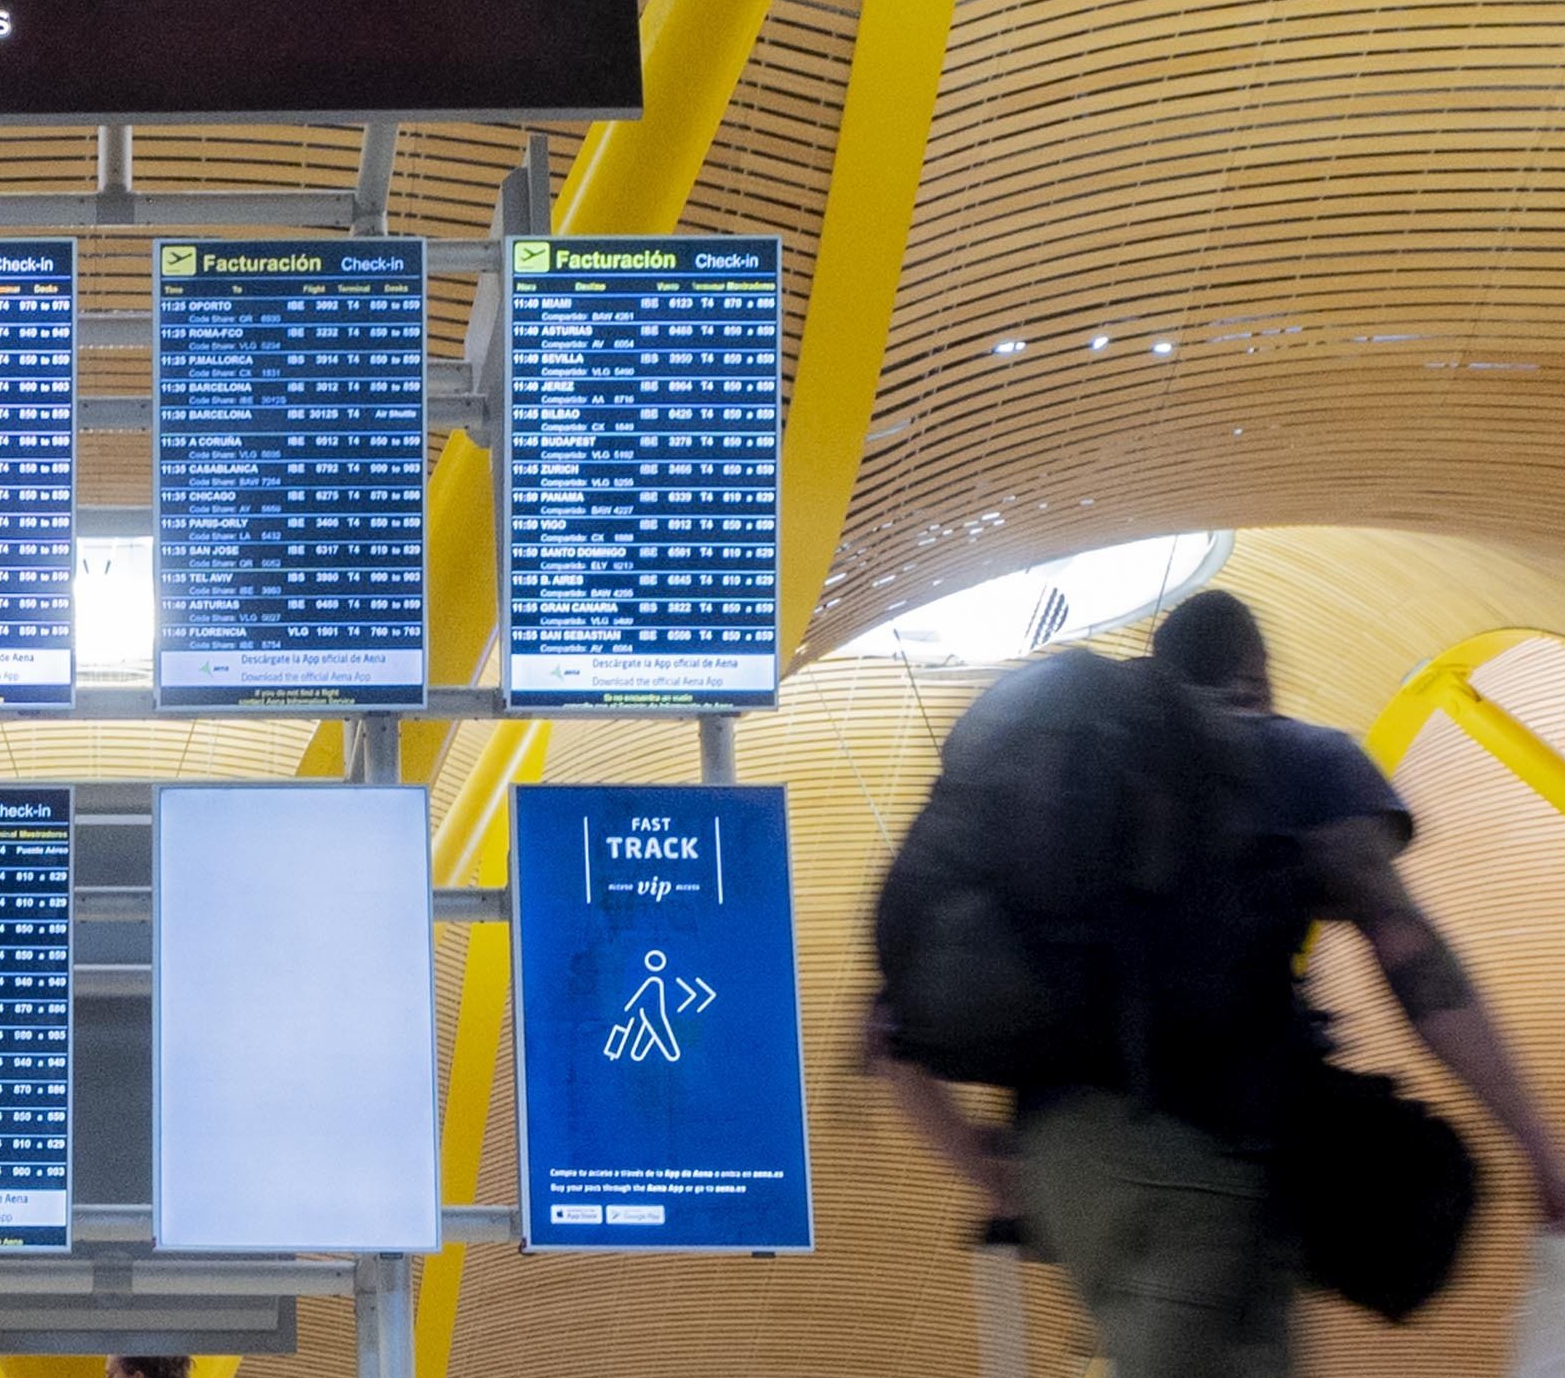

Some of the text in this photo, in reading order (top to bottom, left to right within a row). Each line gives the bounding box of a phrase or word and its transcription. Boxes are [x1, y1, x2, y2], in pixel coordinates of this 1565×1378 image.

[203, 254, 404, 273] Facturación Check-in
[556, 250, 759, 270] Facturación Check-in
[189, 302, 231, 311] OPORTO
[189, 383, 251, 392] BARCELONA
[189, 410, 251, 419] BARCELONA
[189, 492, 236, 501] CHICAGO
[242, 654, 290, 665] Descárgate
[303, 654, 319, 665] App
[322, 654, 349, 663] oficial
[352, 654, 362, 663] de
[364, 654, 385, 663] Aena
[242, 673, 283, 681] Download
[285, 673, 298, 681] the
[331, 673, 352, 681] Aena
[354, 673, 371, 683] App
[632, 817, 671, 831] FAST
[606, 837, 699, 859] TRACK
[637, 876, 671, 902] vip
[5, 1194, 28, 1203] Aena
